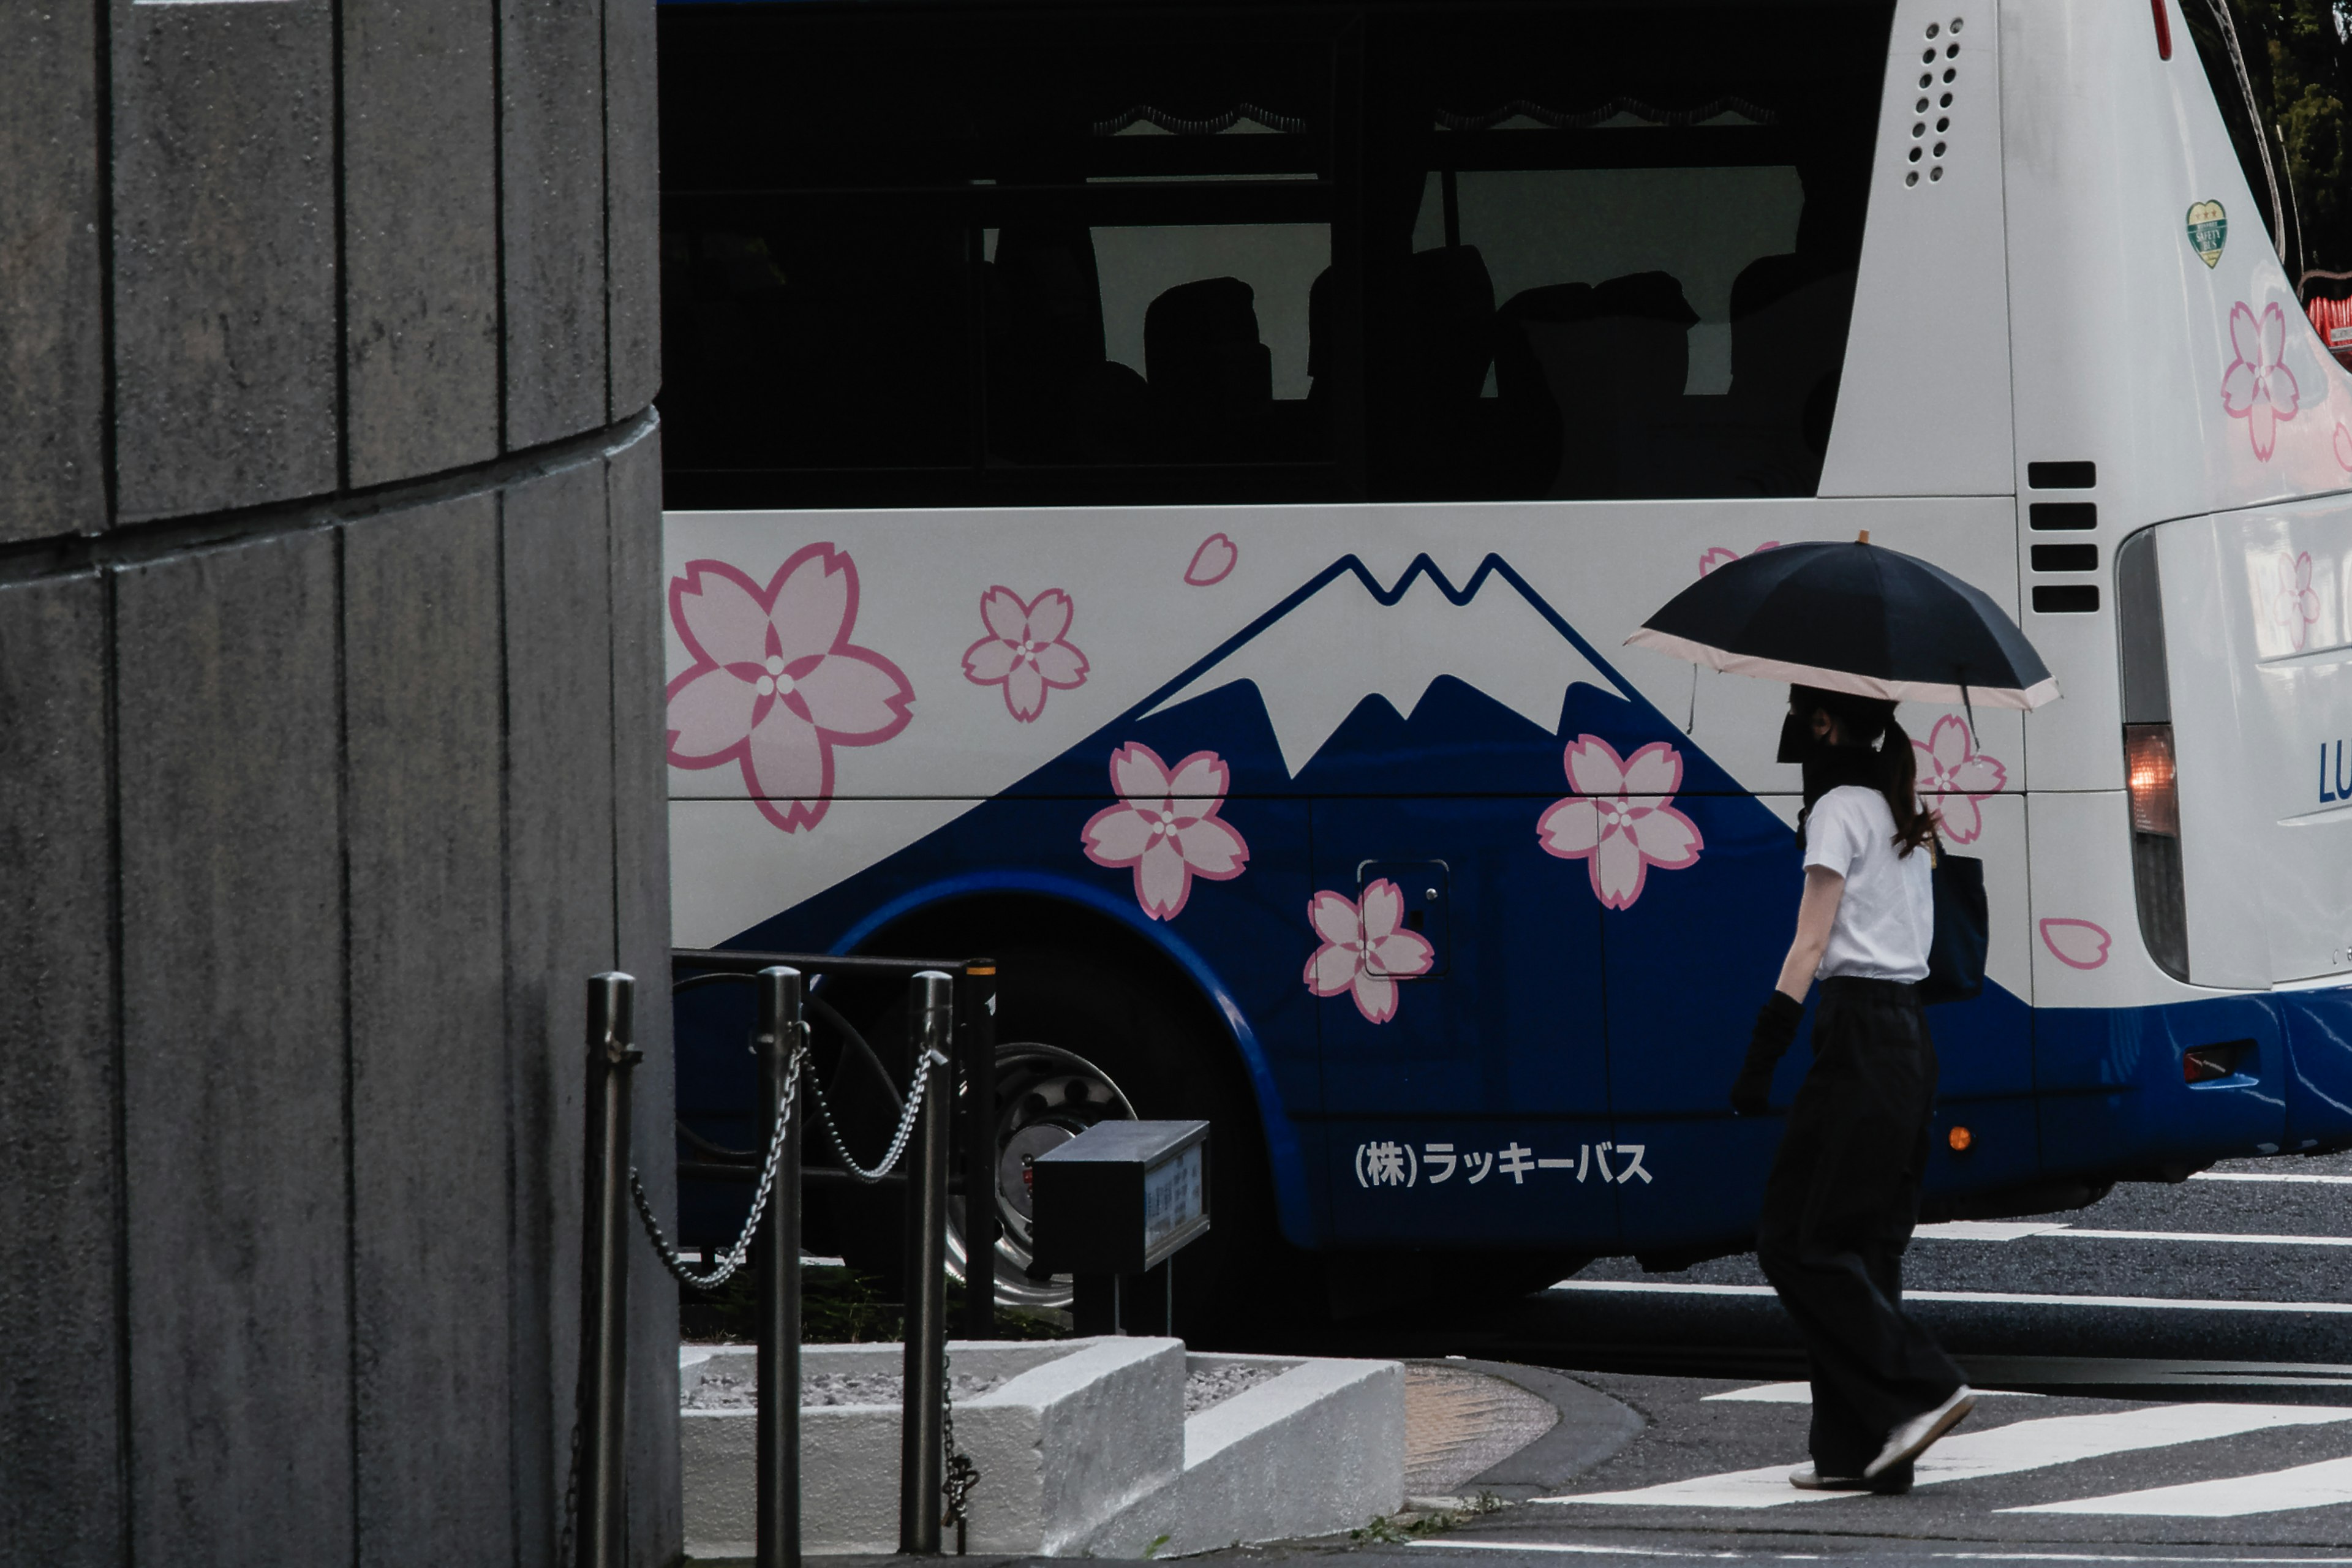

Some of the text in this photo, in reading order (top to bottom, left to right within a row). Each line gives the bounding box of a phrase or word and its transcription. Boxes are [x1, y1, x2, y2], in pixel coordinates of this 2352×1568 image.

[2196, 230, 2220, 243] SAFETY
[1355, 1140, 1653, 1188] (株)ラッキーバス
